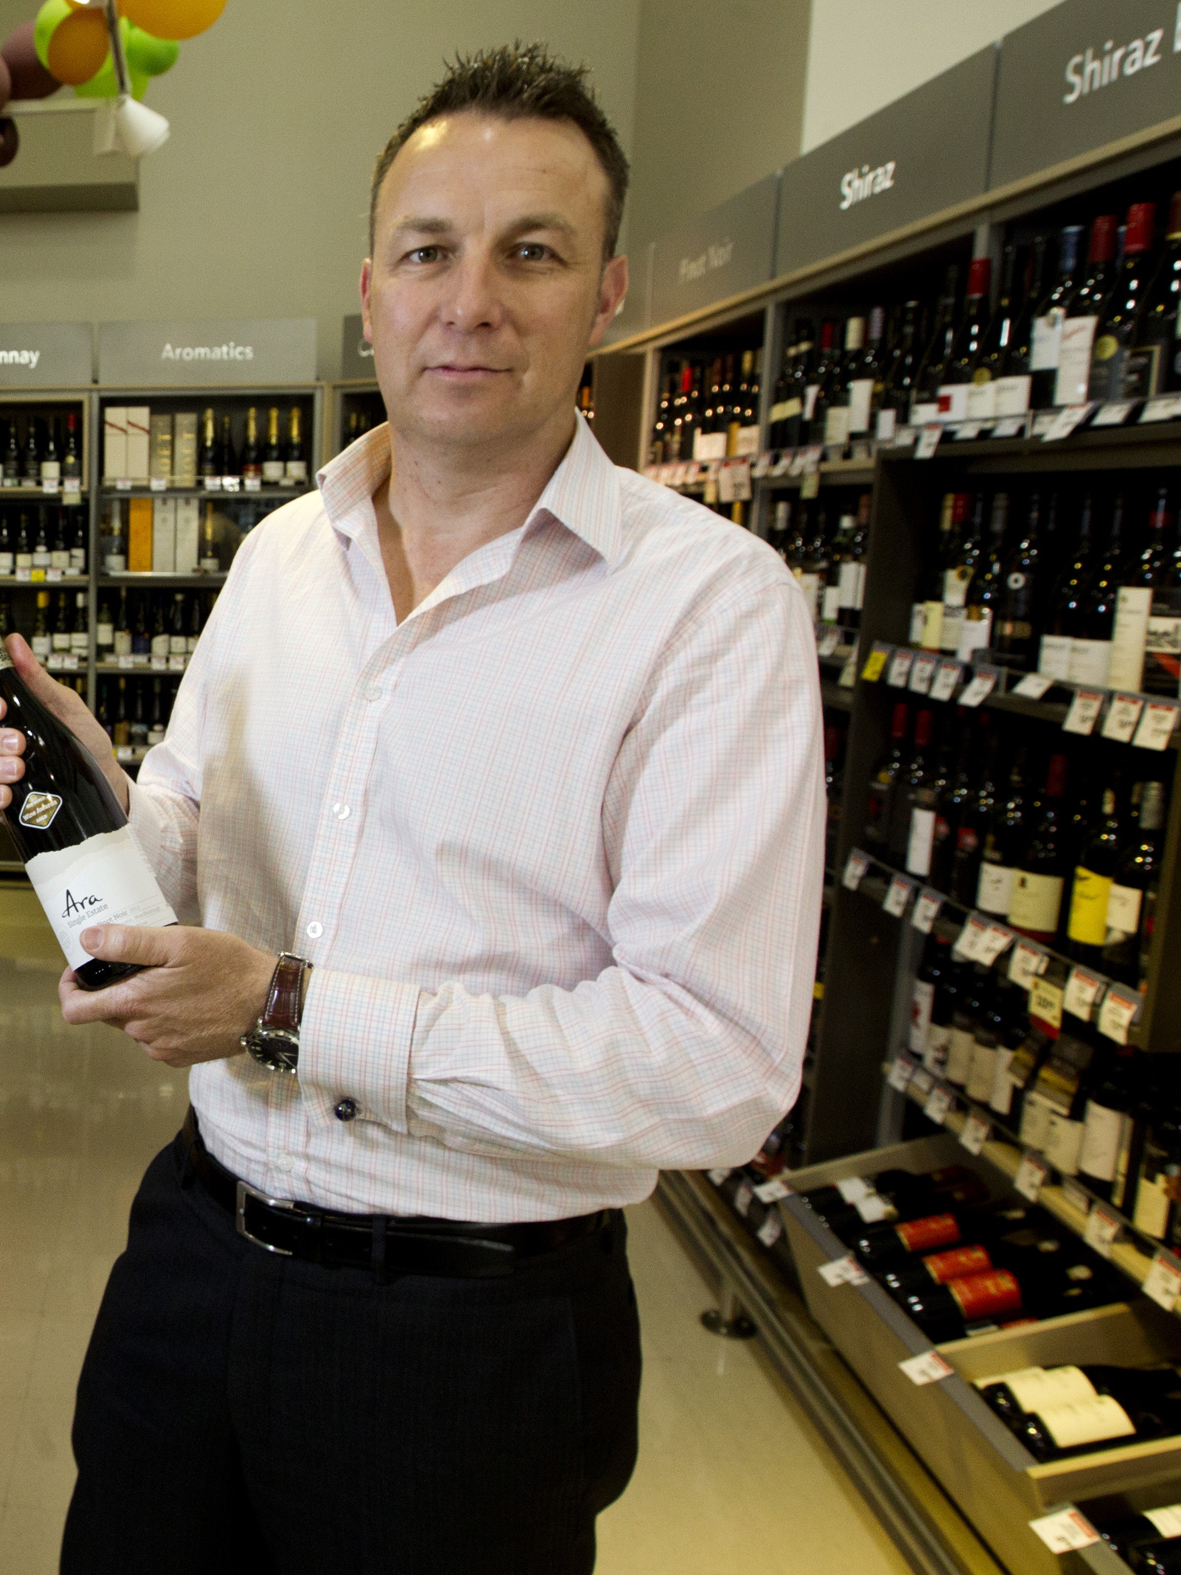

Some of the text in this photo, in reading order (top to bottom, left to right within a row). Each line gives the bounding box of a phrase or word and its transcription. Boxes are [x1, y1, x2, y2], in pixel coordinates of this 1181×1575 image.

[1063, 27, 1164, 104] Shiraz
[840, 161, 896, 210] Shiraz
[161, 342, 254, 361] Aromatics
[62, 889, 103, 919] Ara
[66, 902, 109, 929] Single Estate
[114, 909, 128, 922] Noir
